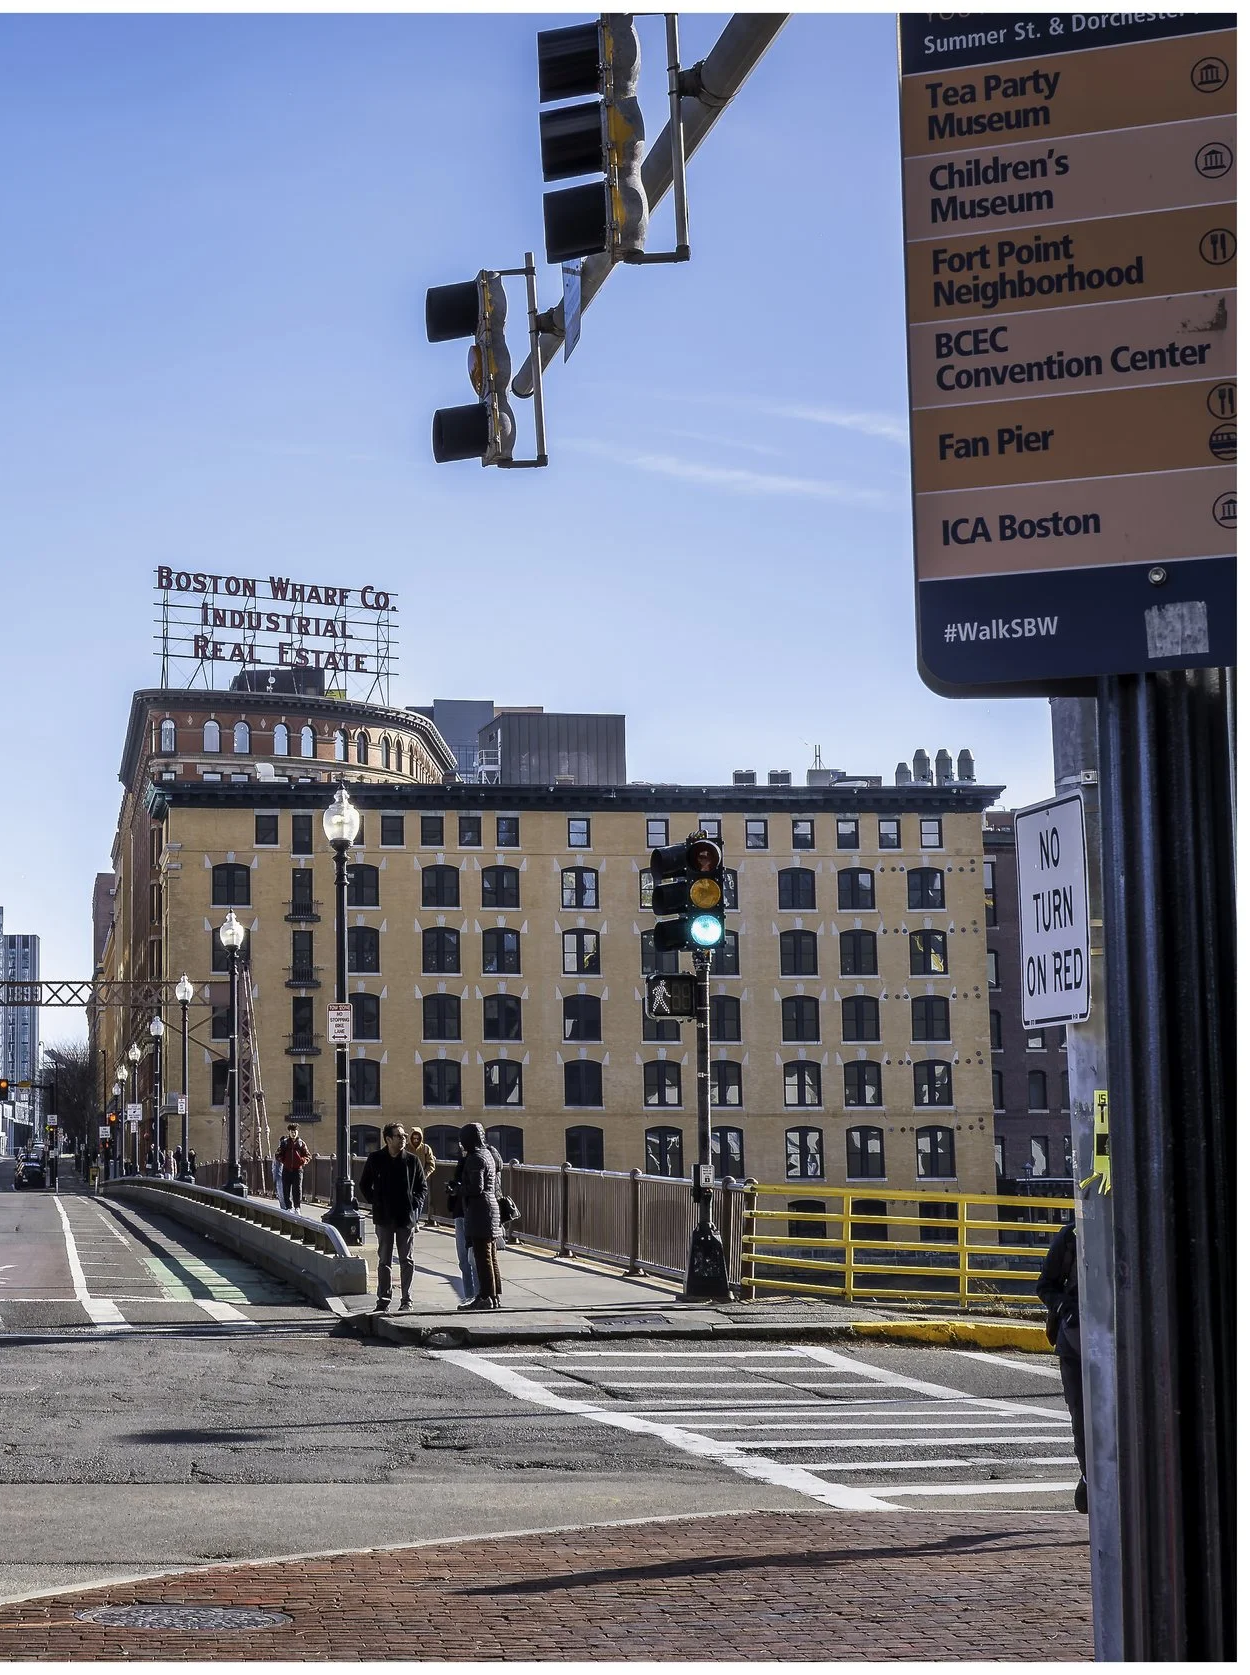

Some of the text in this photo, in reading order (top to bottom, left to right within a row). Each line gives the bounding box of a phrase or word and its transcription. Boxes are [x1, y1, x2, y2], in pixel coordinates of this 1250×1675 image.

[924, 28, 1007, 54] Summer
[1014, 22, 1041, 41] St.
[1049, 17, 1064, 36] &
[925, 69, 1061, 109] Tea Party
[927, 105, 1051, 141] Museum
[929, 149, 1069, 191] Children's
[930, 189, 1054, 223] Museum
[932, 234, 1074, 275] Fort Point
[933, 256, 1144, 309] Neighborhood
[935, 326, 1009, 359] BCEC
[935, 342, 1211, 391] Convention Center
[938, 425, 1054, 461] Fan Pier
[942, 511, 1101, 546] ICA Boston
[157, 565, 257, 598] BOSTON
[269, 576, 351, 606] WHARF
[201, 602, 353, 639] INDUSTRIAL
[944, 615, 1058, 643] #WalkSBW
[193, 634, 261, 663] REAL
[278, 641, 368, 672] ESTATE
[1039, 826, 1060, 871] NO
[1032, 885, 1074, 934] TURN
[1027, 947, 1083, 997] ON RED
